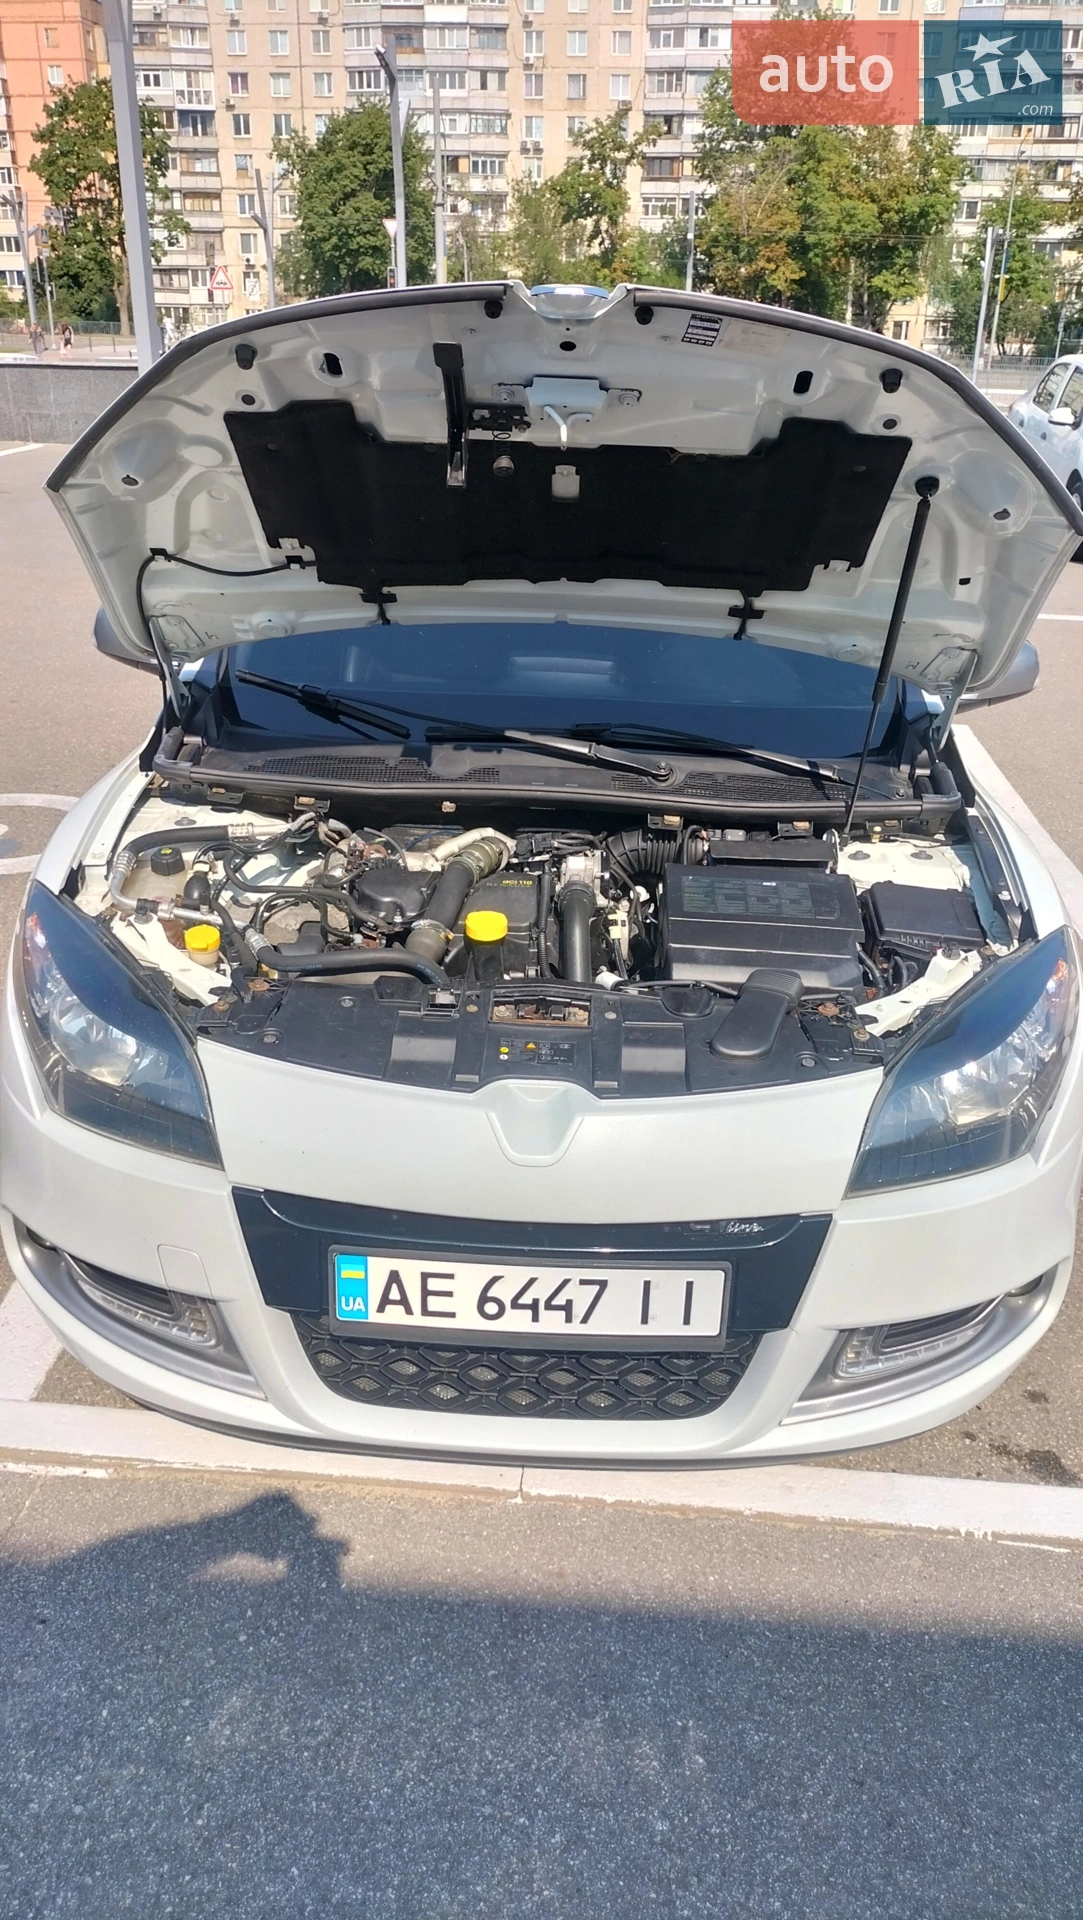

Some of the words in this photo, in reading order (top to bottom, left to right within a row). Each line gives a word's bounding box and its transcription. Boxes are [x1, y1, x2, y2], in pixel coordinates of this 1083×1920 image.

[341, 1296, 366, 1312] UA
[376, 1269, 457, 1318] AE
[476, 1275, 609, 1325] 6447
